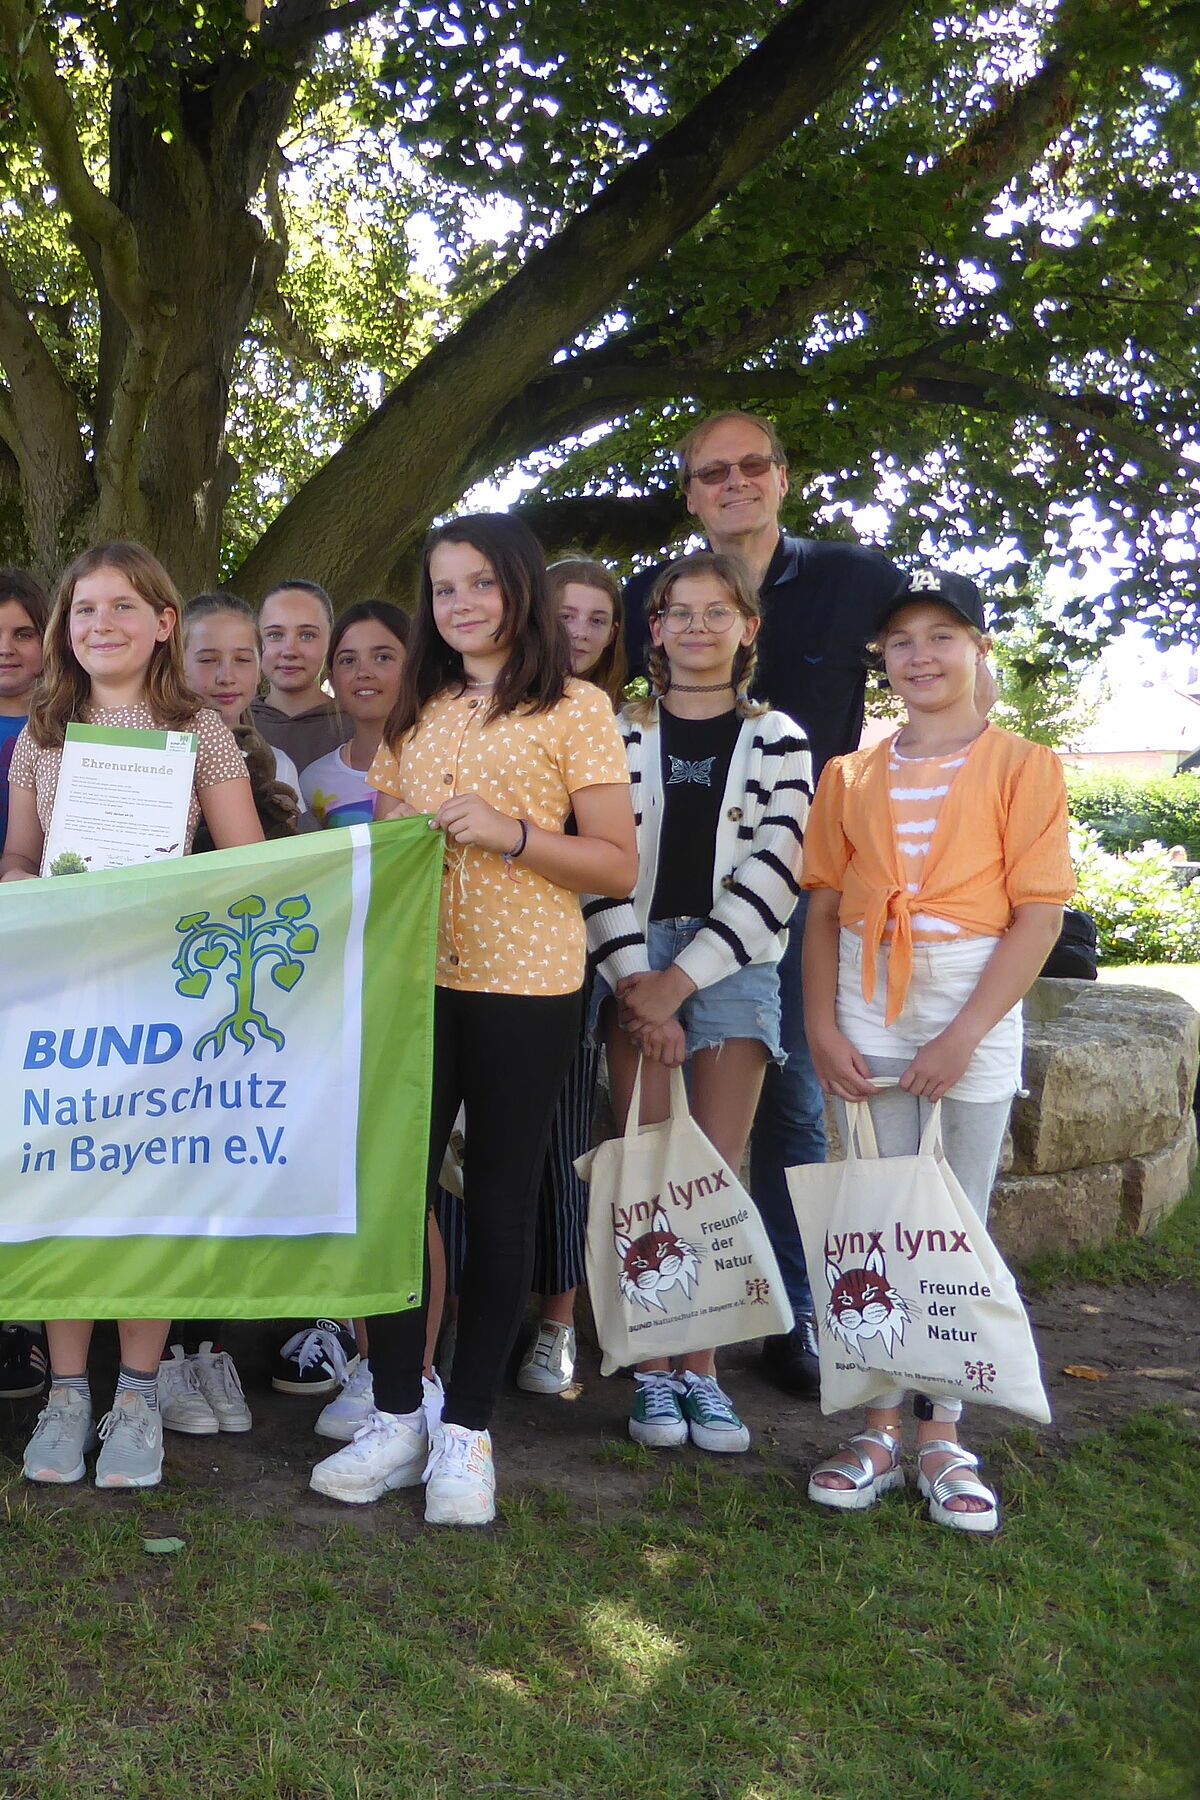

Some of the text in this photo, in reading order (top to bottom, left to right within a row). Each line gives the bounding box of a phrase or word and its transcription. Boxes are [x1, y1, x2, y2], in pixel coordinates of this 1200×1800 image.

[81, 757, 174, 776] Ehrenurkunde
[21, 1022, 184, 1070] BUND
[23, 1073, 288, 1127] Naturschutz
[19, 1126, 288, 1176] in Bayern e.V.
[611, 1168, 730, 1234] Lynx lynx
[700, 1209, 749, 1235] Freunde
[711, 1237, 734, 1251] der
[824, 1222, 972, 1263] Lynx lynx
[714, 1254, 753, 1271] Natur
[919, 1280, 991, 1297] Freunde
[928, 1302, 956, 1317] der
[628, 1321, 652, 1332] BUND
[653, 1310, 698, 1326] Naturschutz
[927, 1324, 977, 1342] Natur
